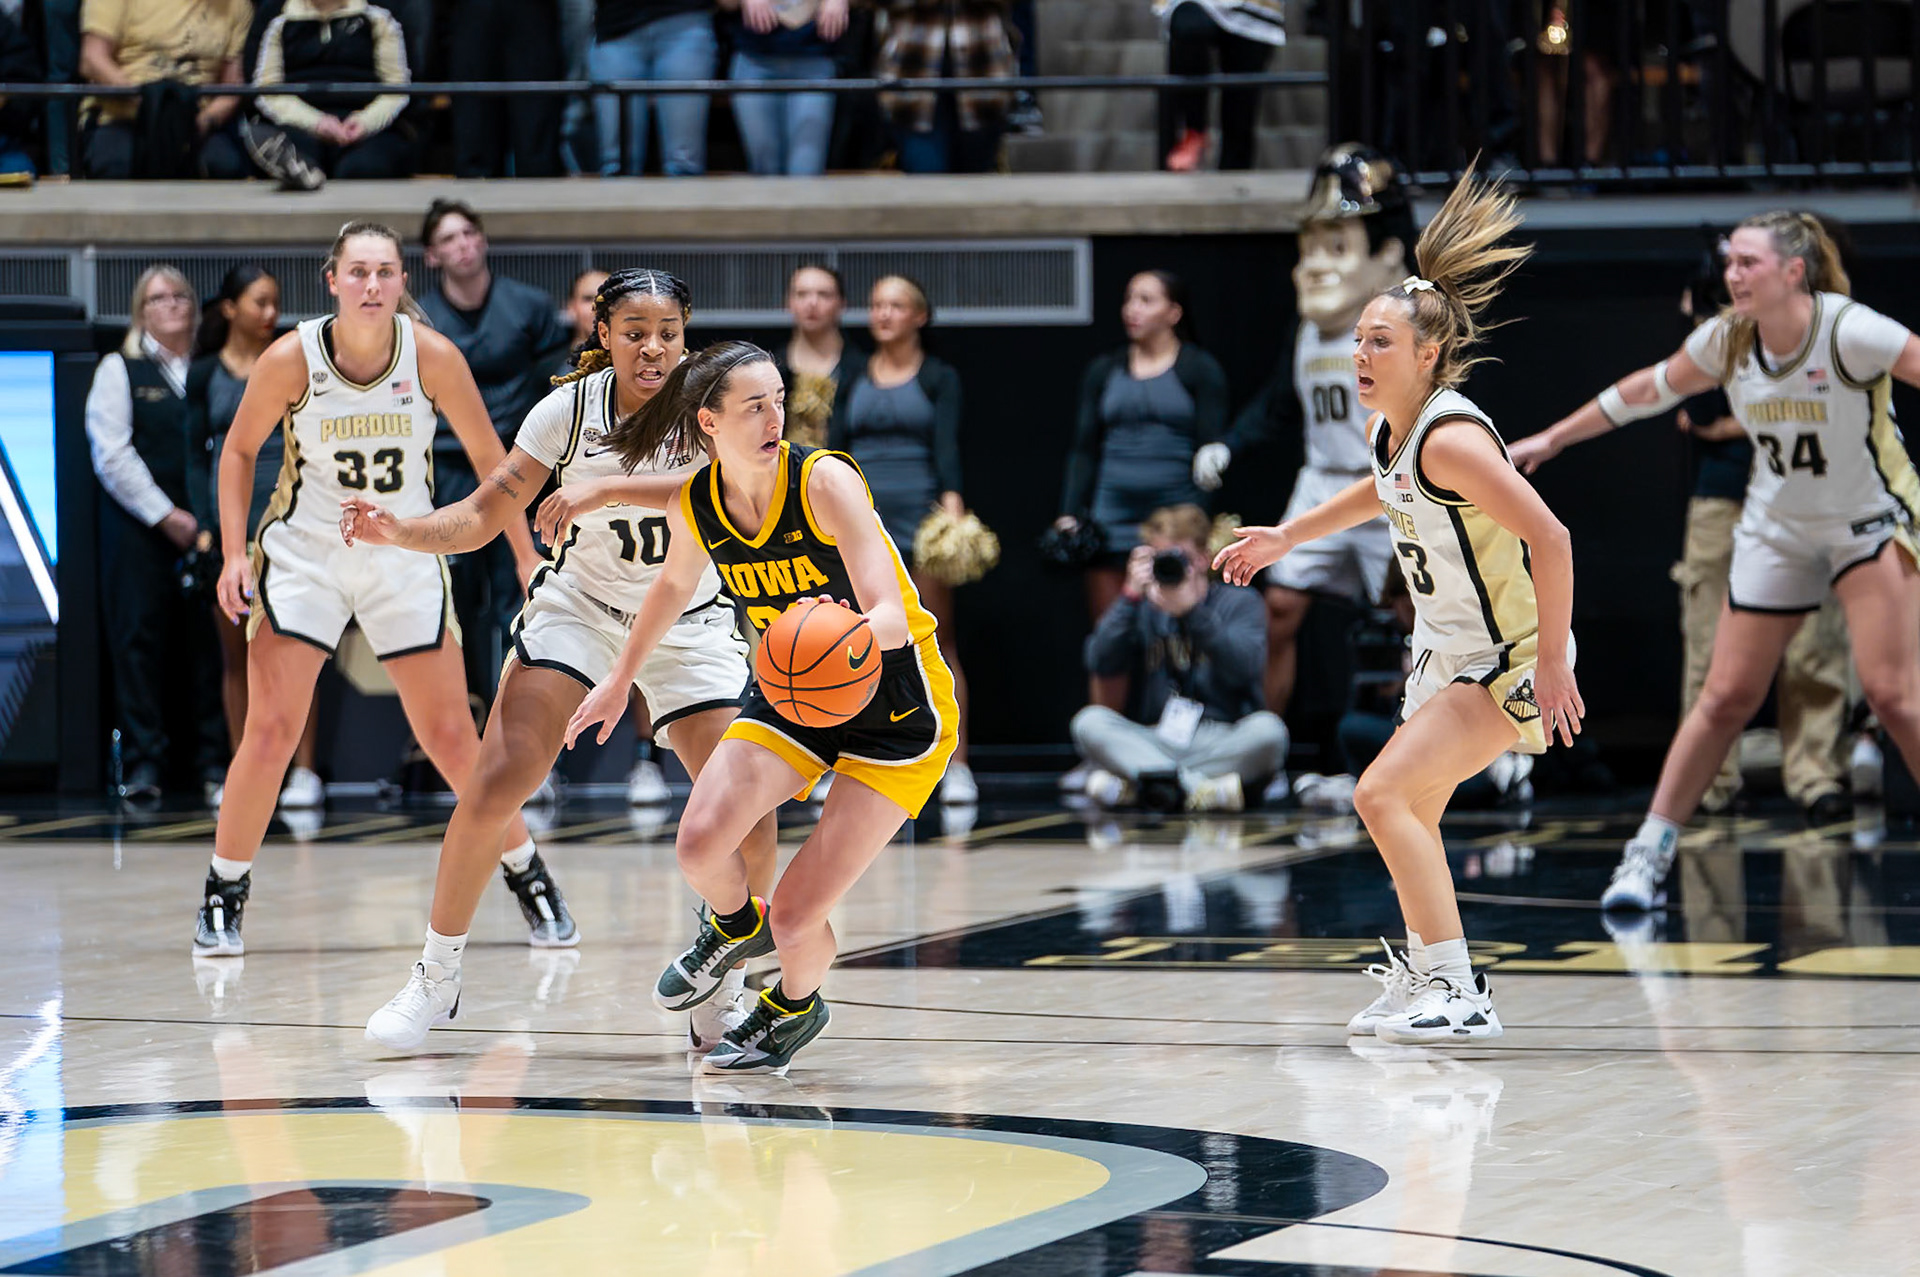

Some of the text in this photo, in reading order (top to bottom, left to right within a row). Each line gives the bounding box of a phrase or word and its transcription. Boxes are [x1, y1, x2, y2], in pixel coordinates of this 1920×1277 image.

[321, 413, 413, 443] PURDUE
[333, 447, 405, 494] 33
[1757, 432, 1828, 477] 34
[608, 515, 673, 567] 10
[718, 554, 830, 599] IOWA
[1397, 541, 1436, 597] 3
